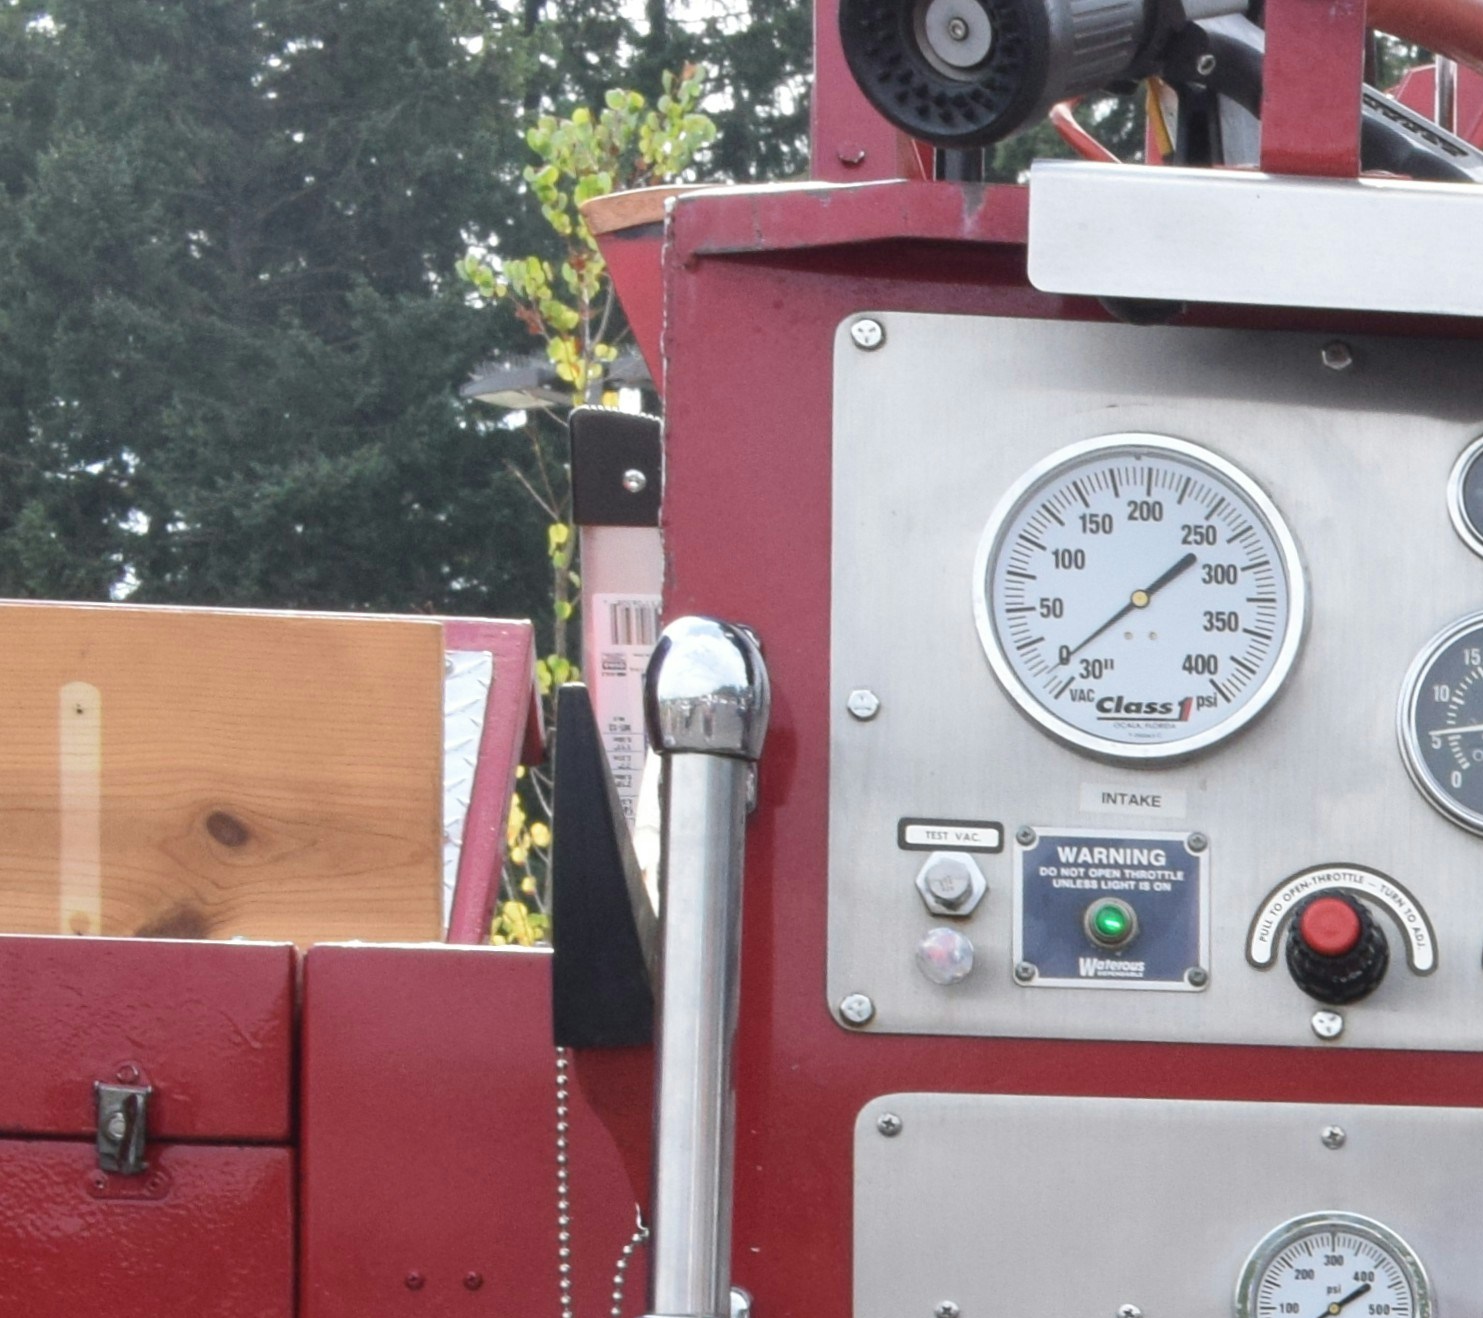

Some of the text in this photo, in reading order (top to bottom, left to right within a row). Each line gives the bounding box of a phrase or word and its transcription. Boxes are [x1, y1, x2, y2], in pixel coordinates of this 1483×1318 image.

[1127, 501, 1163, 521] 200
[1080, 514, 1113, 534] 150
[1181, 525, 1217, 546] 250
[1052, 549, 1085, 569] 100
[1202, 564, 1237, 584] 300
[1040, 598, 1064, 618] 50
[1202, 611, 1239, 632] 350
[1182, 654, 1218, 675] 400
[1464, 649, 1482, 665] 15
[1433, 685, 1450, 701] 10
[1102, 792, 1161, 808] INTAKE
[926, 830, 949, 841] TEST
[1057, 847, 1166, 866] WARNING
[1039, 867, 1184, 881] DO NOT OPEN THROTTLE
[1052, 880, 1171, 891] UNLESS LIGHT IS ON
[1079, 957, 1145, 977] Waterous
